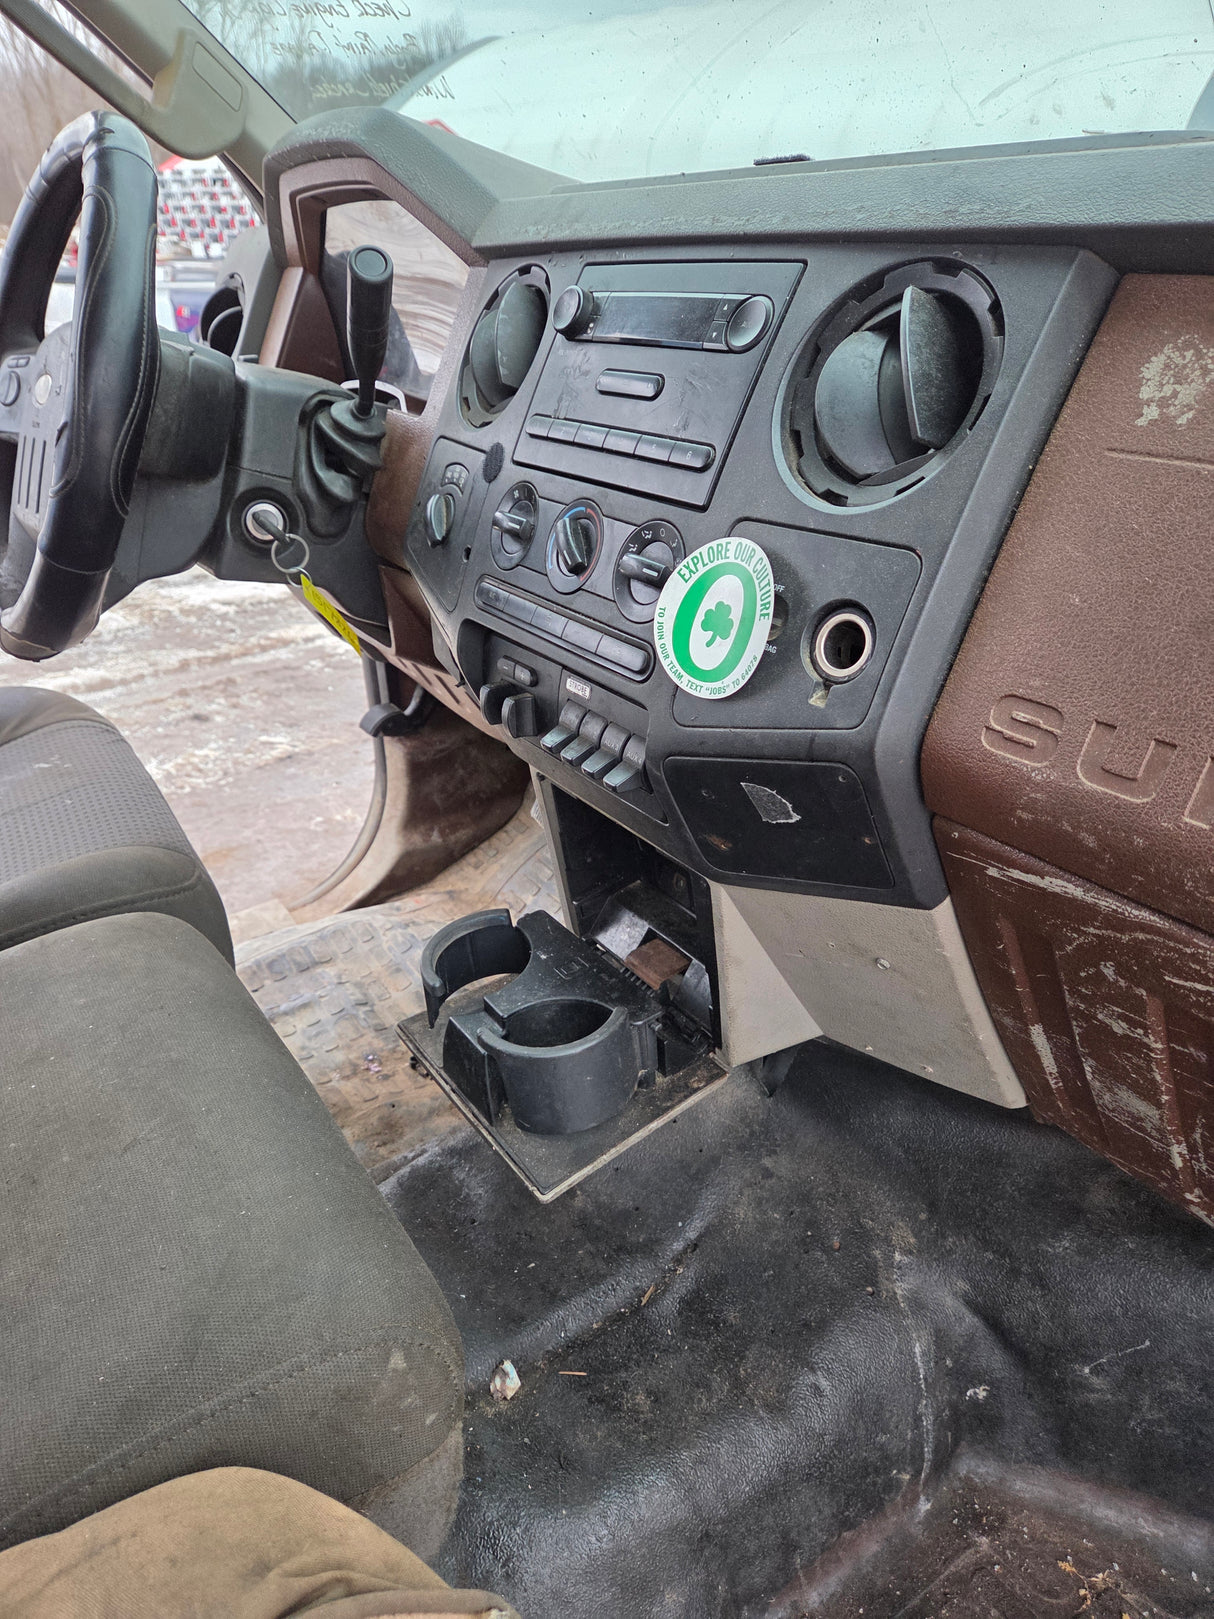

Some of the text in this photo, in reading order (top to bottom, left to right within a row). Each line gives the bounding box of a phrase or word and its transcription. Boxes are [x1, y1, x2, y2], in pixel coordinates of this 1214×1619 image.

[677, 541, 771, 621] EXPLORE OUR CULTURE
[657, 607, 666, 618] TO
[660, 643, 669, 660] OUR
[667, 661, 684, 684] TEAM,
[685, 679, 704, 693] TEXT
[731, 678, 741, 688] TO
[981, 694, 1213, 829] SU
